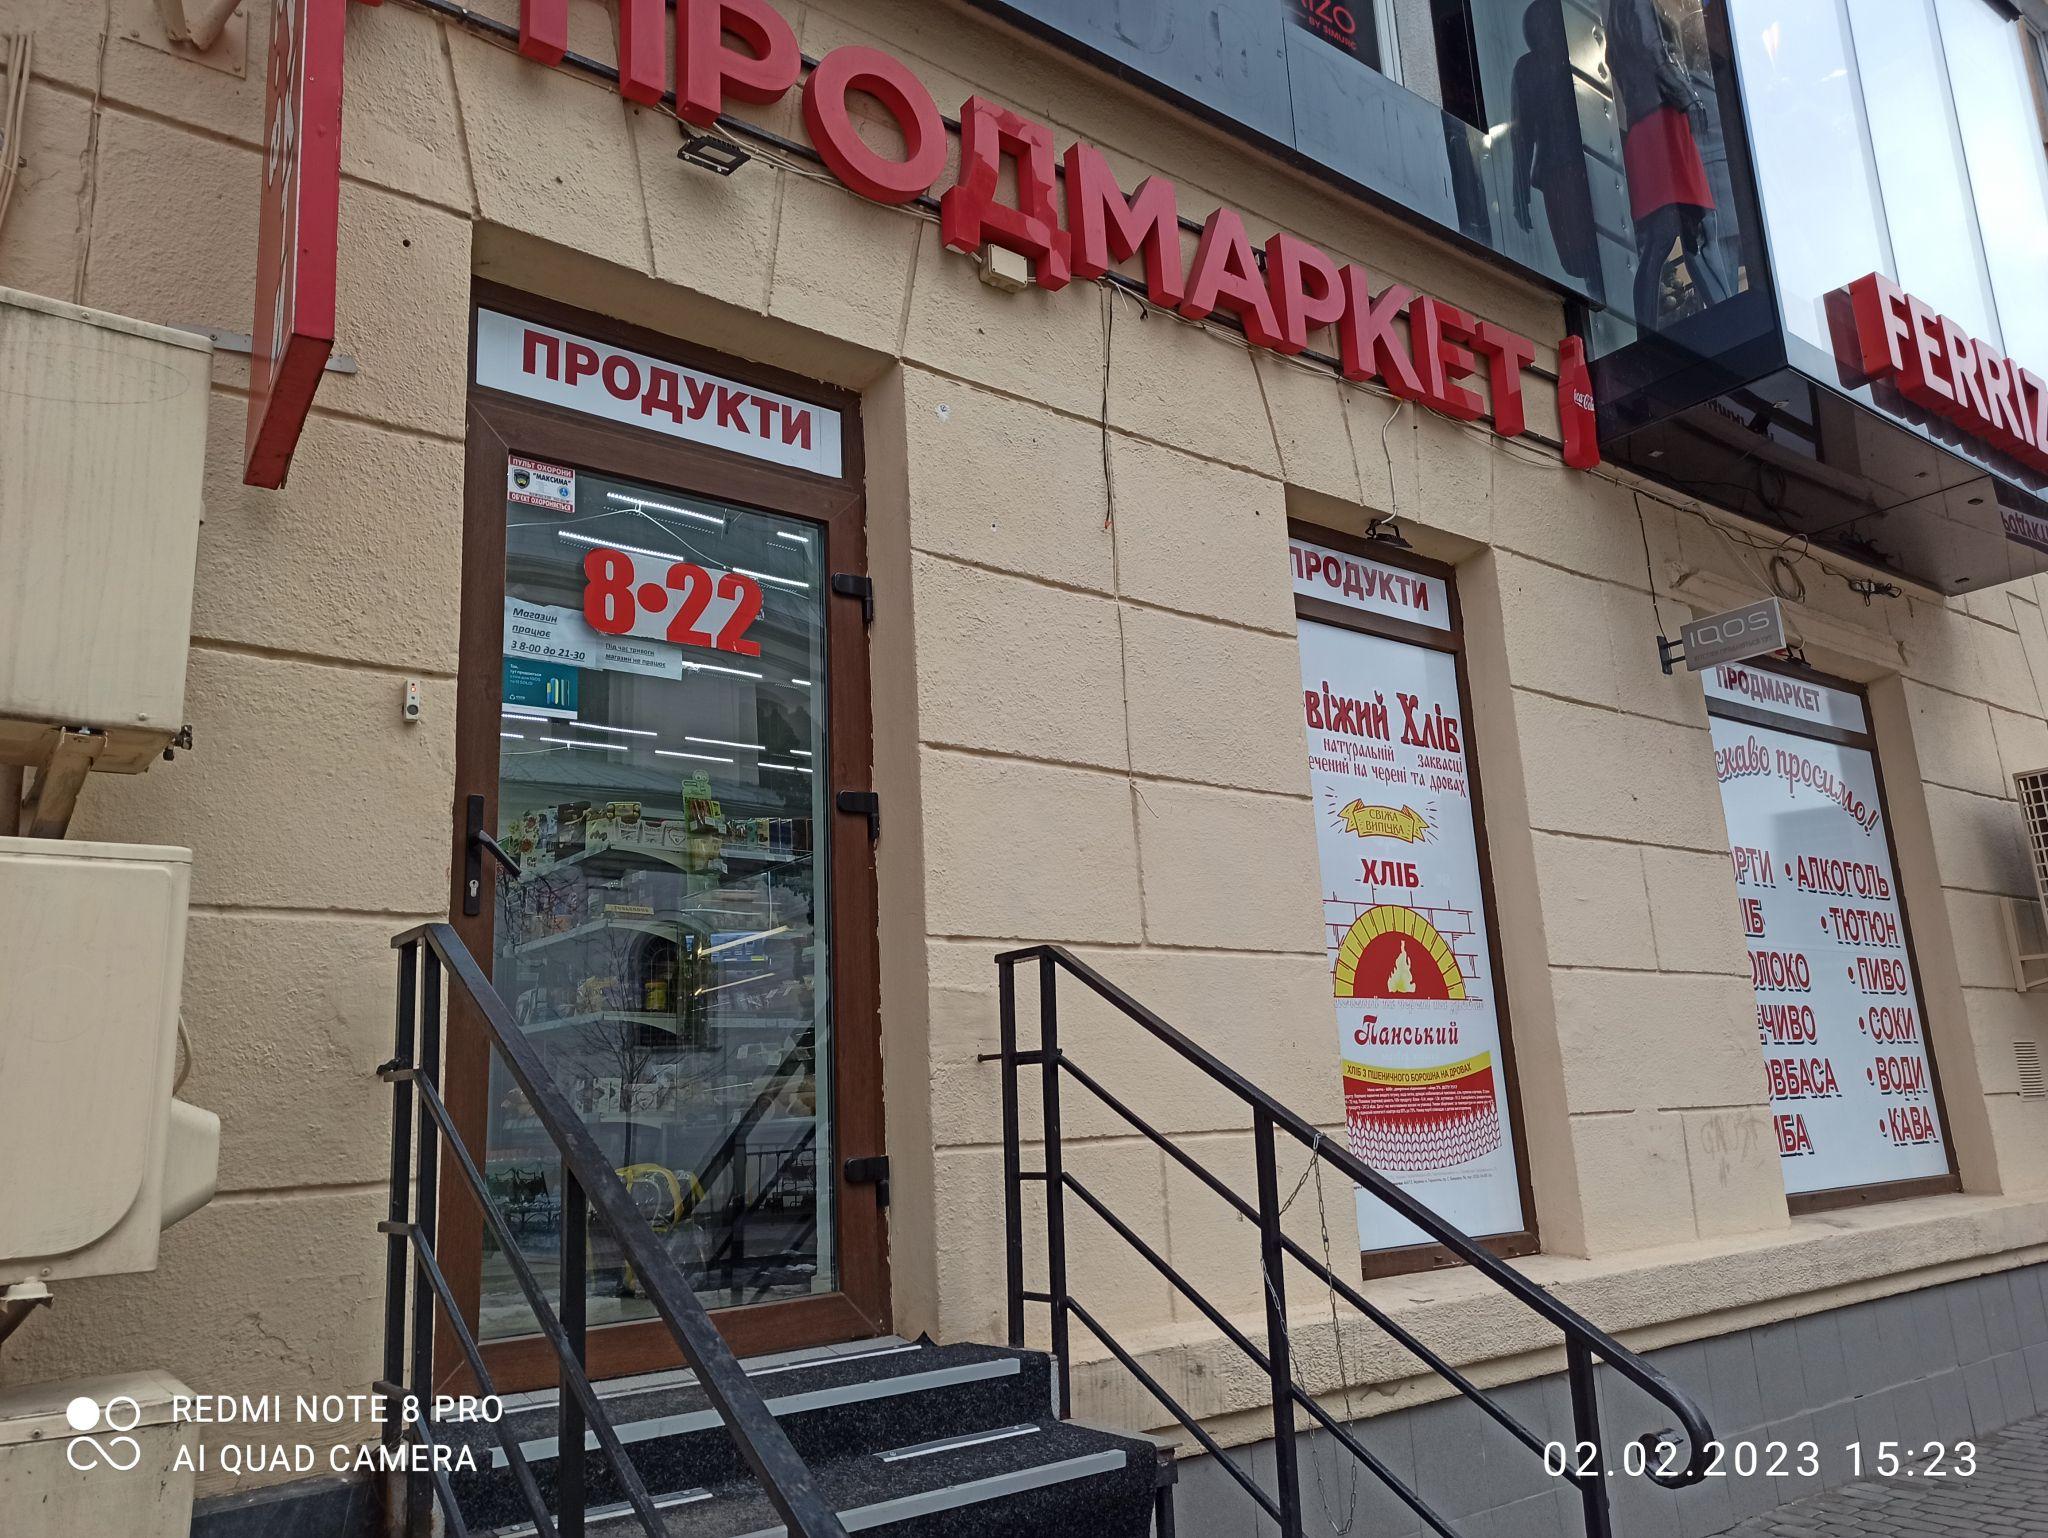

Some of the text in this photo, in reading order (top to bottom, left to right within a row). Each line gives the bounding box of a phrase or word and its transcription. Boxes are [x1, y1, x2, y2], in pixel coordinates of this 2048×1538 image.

[522, 328, 813, 452] ПРОДУКТИ
[512, 458, 572, 478] ПУЛЬТ ОХОРОНИ
[1289, 546, 1429, 612] ПРОДУКТИ
[511, 625, 552, 638] працює
[512, 607, 558, 623] Магазин
[1689, 610, 1770, 648] IQOS
[519, 641, 541, 653] 8-00
[543, 646, 556, 655] до
[557, 648, 586, 660] 21-30
[1715, 664, 1821, 712] ПРОДМАРКЕТ
[1304, 681, 1390, 742] віжий
[1353, 763, 1368, 778] на
[1410, 771, 1426, 786] та
[1365, 819, 1404, 835] ВИПІЧКА
[1369, 808, 1398, 822] СВІЖА
[1361, 858, 1420, 888] ХЛІБ
[1731, 846, 1890, 898] РТИ АЛКОГОЛЬ
[1739, 898, 1898, 946] ІБ ТЮТЮН
[1856, 957, 1907, 993] ПИВО
[1354, 1014, 1459, 1046] Панський
[1868, 1006, 1916, 1042] СОКИ
[1347, 1064, 1361, 1076] ХЛІБ
[1367, 1069, 1410, 1082] ПШЕНИЧНОГО
[1410, 1071, 1440, 1082] БОРОШНА
[1440, 1068, 1449, 1078] НА
[1449, 1062, 1472, 1077] ДРОВАХ
[1875, 1056, 1925, 1098] ВОДИ
[1888, 1106, 1938, 1142] КАВА
